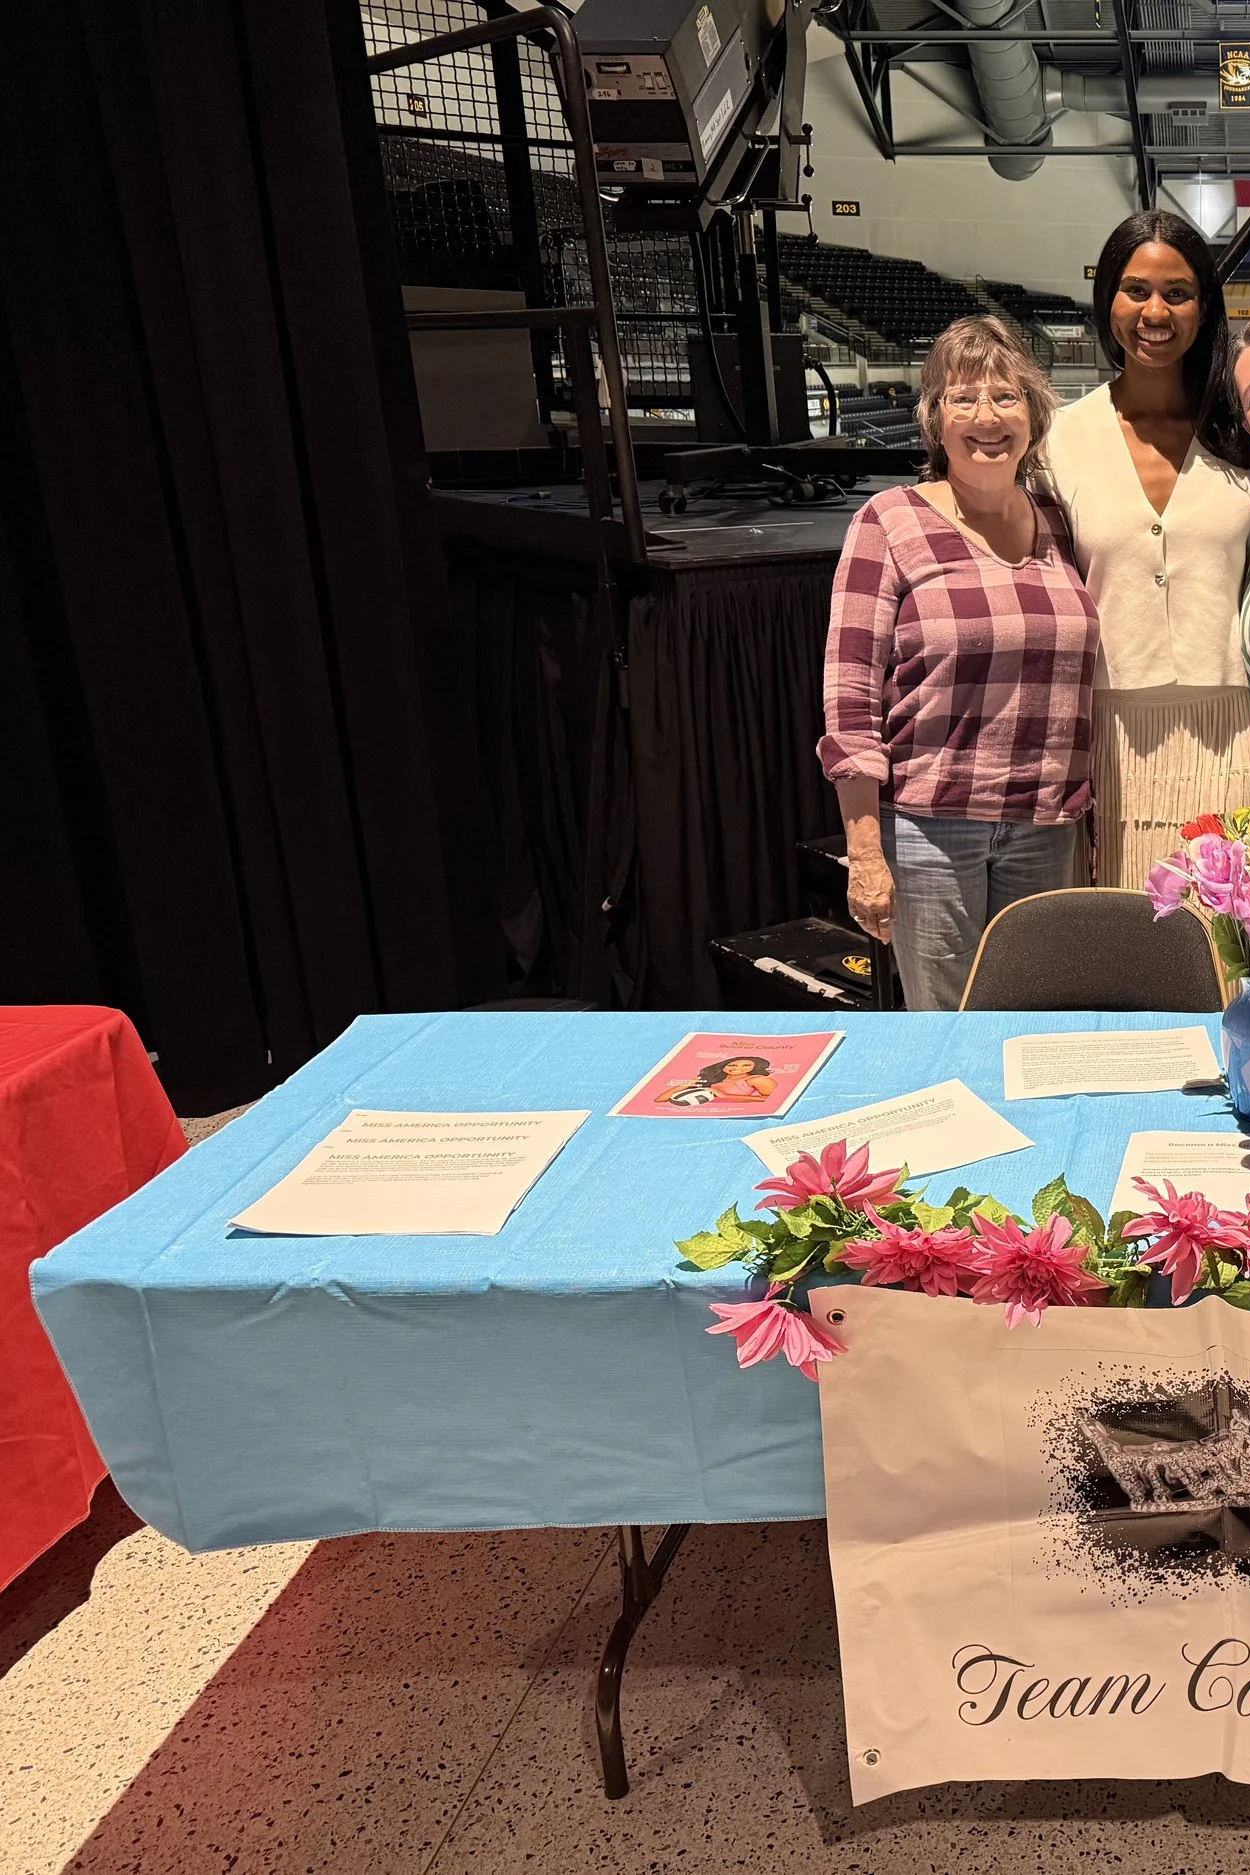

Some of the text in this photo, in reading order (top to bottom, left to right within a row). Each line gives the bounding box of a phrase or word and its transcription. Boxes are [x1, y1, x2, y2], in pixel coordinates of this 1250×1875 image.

[1227, 50, 1249, 59] NCAA
[835, 204, 857, 213] 203
[361, 1119, 545, 1129] MISS AMERICA OPPORTUNITY
[769, 1135, 800, 1145] MISS
[802, 1121, 857, 1140] AMERICA
[856, 1097, 937, 1124] OPPORTUNITY
[345, 1134, 531, 1145] MISS AMERICA OPPORTUNITY
[328, 1151, 516, 1161] MISS AMERICA OPPORTUNITY
[950, 1640, 1169, 1728] Team
